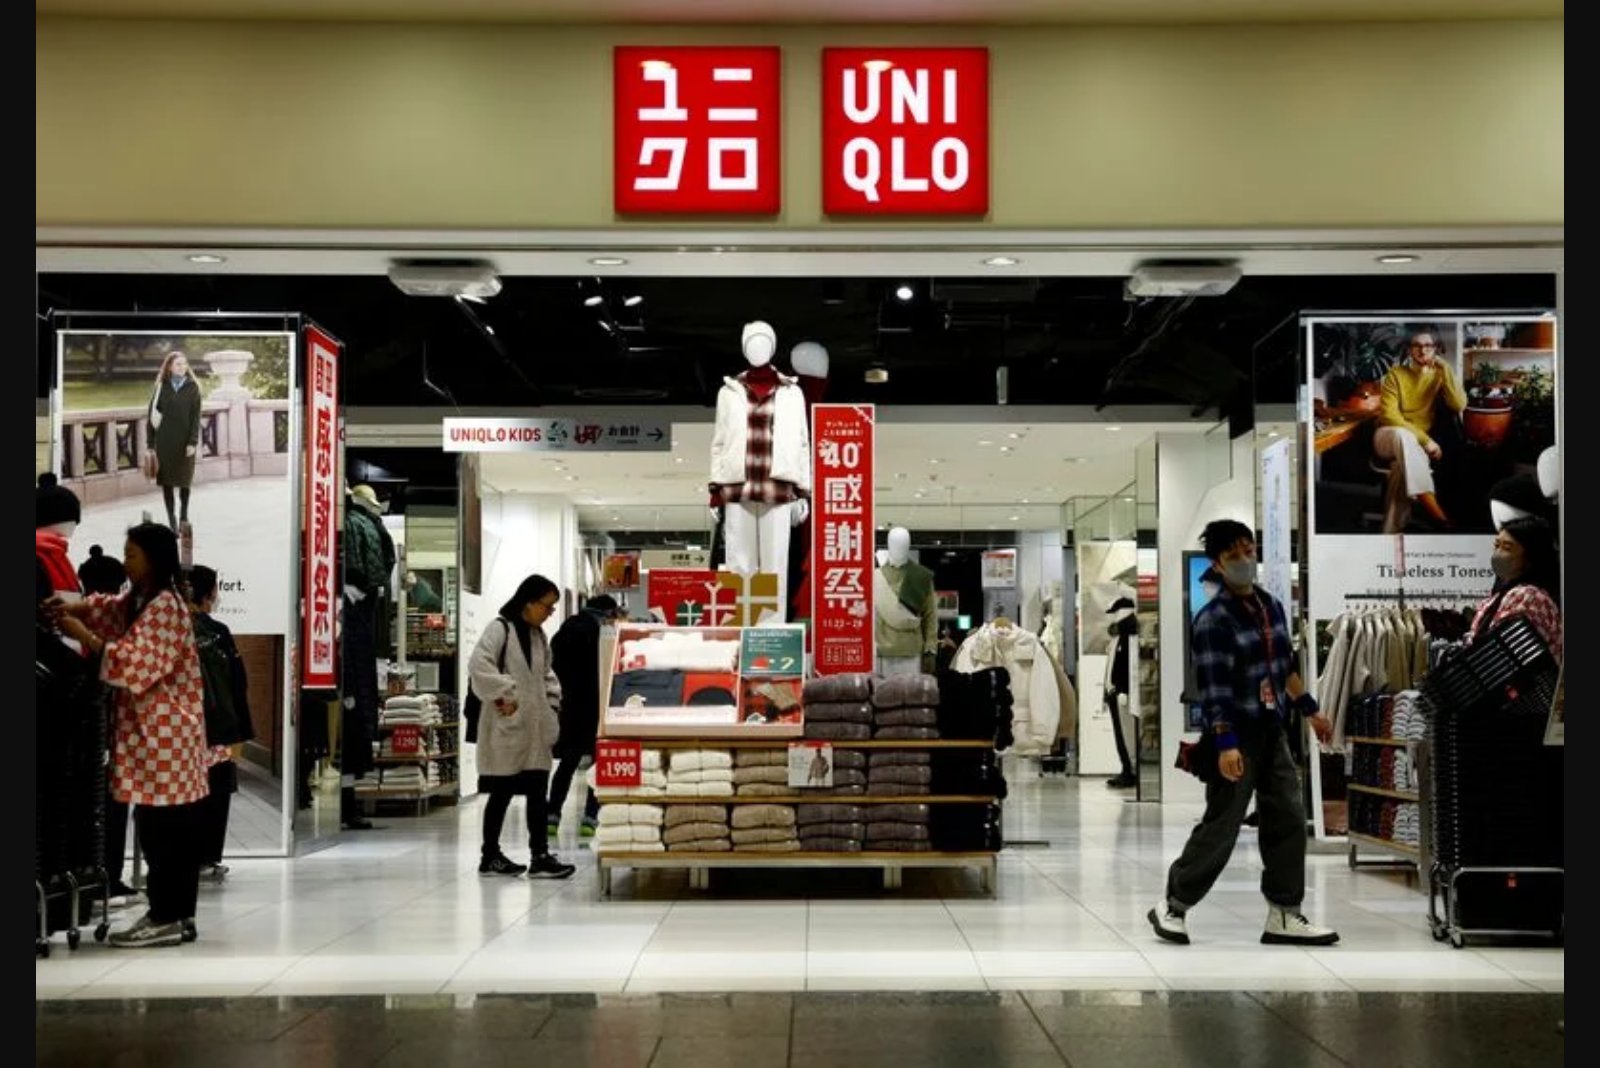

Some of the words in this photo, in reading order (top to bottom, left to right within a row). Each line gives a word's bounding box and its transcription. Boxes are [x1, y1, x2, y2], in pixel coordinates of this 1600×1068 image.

[842, 67, 958, 124] UNI
[842, 137, 969, 201] QLO
[450, 428, 506, 443] UNIQLO
[508, 428, 541, 441] KIDS
[824, 474, 863, 609] 感謝祭
[1376, 564, 1445, 579] Tieless
[1448, 564, 1493, 579] Tones
